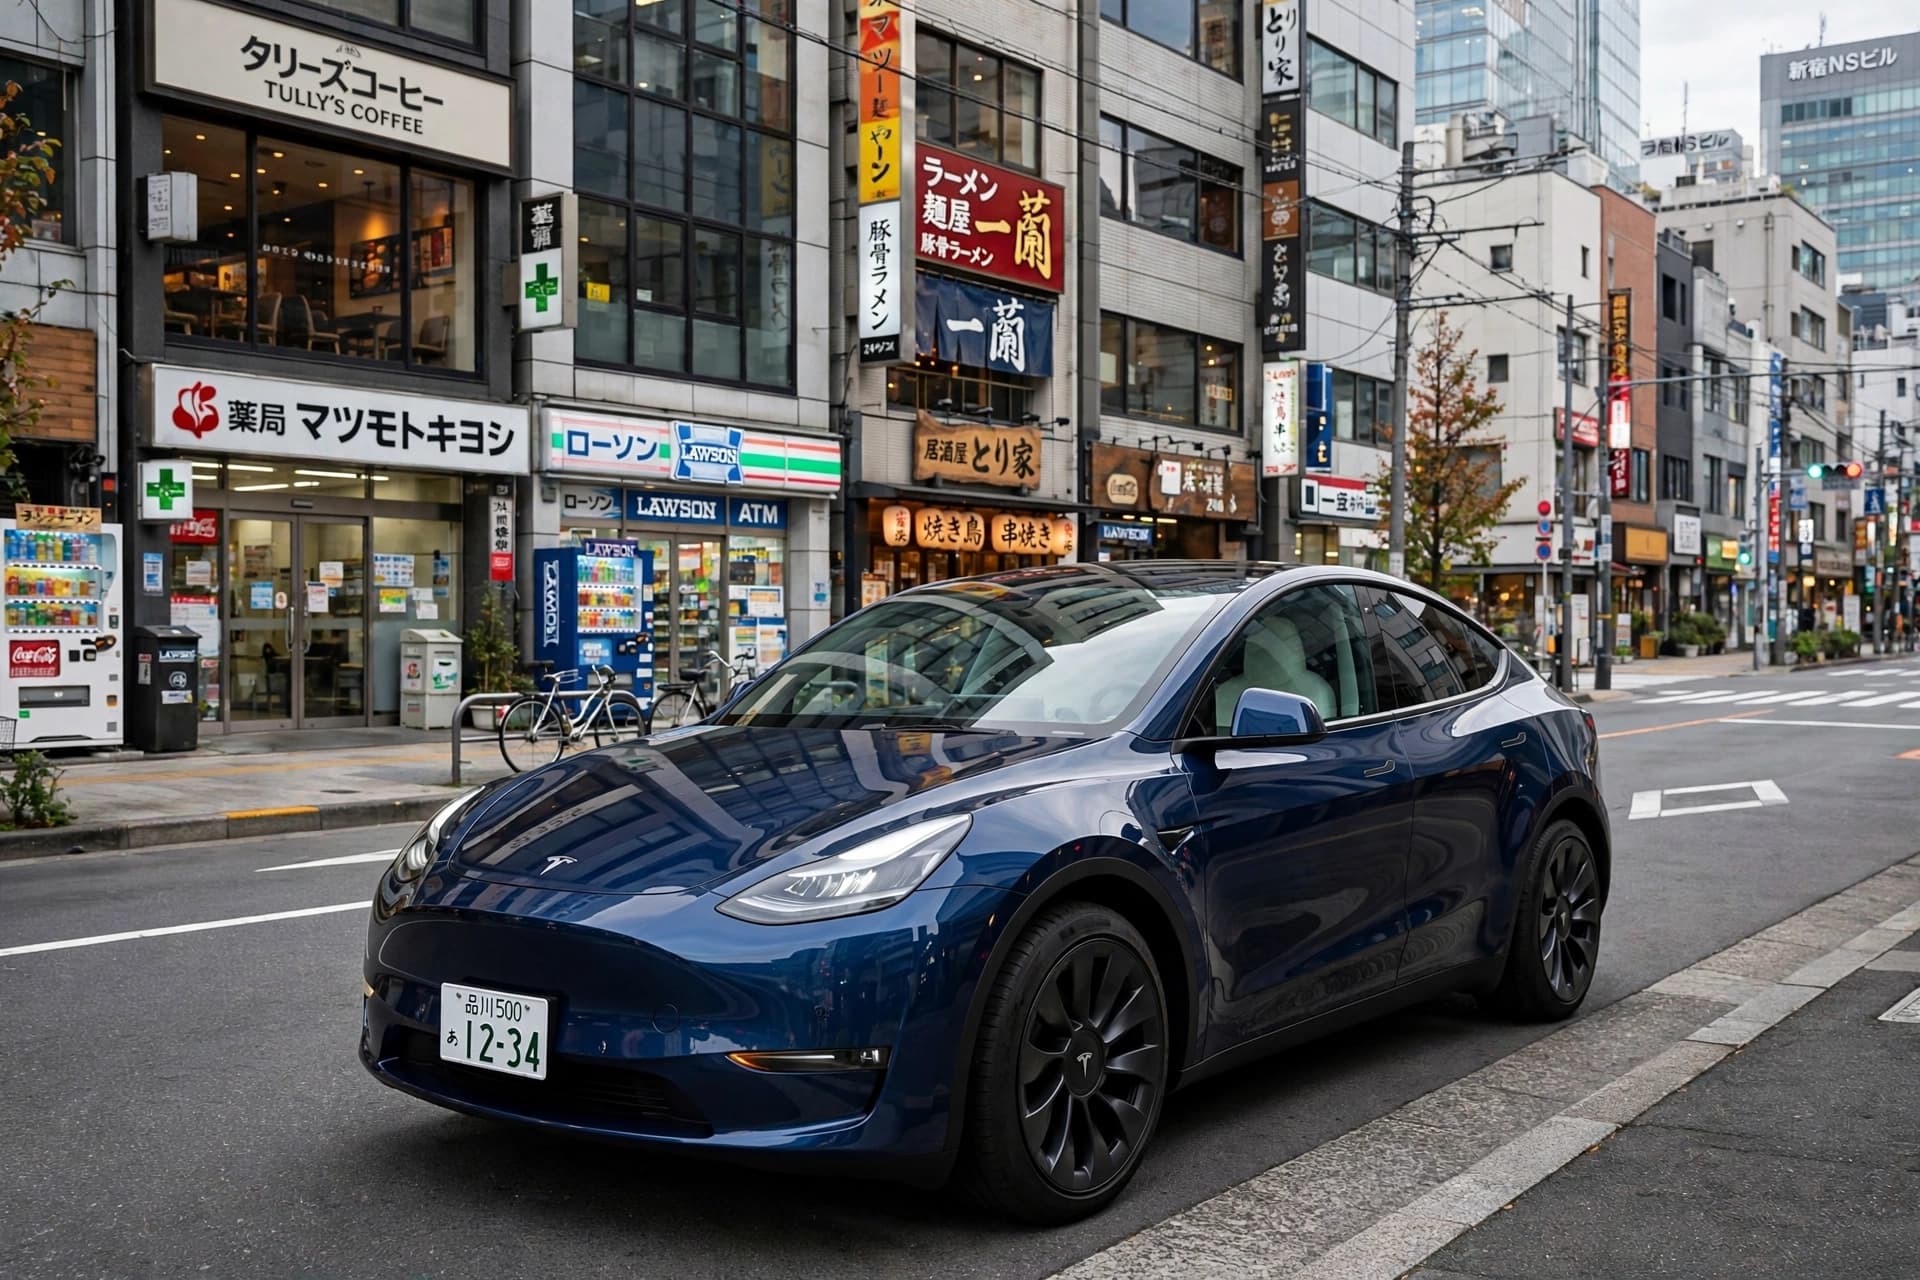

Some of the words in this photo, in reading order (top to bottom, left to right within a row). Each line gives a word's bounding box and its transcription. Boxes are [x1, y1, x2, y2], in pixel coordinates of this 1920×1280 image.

[240, 35, 444, 112] タリーズコーヒー
[1788, 47, 1898, 80] 新宿NSビル
[264, 79, 346, 116] TULLY'S
[351, 103, 424, 135] COFFEE
[922, 156, 998, 202] ラーメン
[922, 189, 972, 237] 麺屋
[920, 232, 994, 268] 豚骨ラーメン
[868, 219, 892, 331] 豚骨ラメン
[946, 297, 1025, 373] 一蘭
[228, 400, 286, 436] 薬局
[296, 402, 515, 457] マツモトキヨシ
[567, 430, 658, 461] ローソン
[681, 443, 738, 465] LAWSON
[924, 438, 968, 465] 居酒屋
[972, 435, 1035, 479] とり家
[564, 494, 613, 512] ローソン
[636, 496, 717, 520] LAWSON
[738, 503, 779, 525] ATM
[923, 515, 982, 546] 焼き鳥
[1001, 519, 1051, 550] 串焼き
[585, 542, 636, 558] LAWSON
[446, 1028, 459, 1047] あ
[466, 1020, 540, 1073] 12-34
